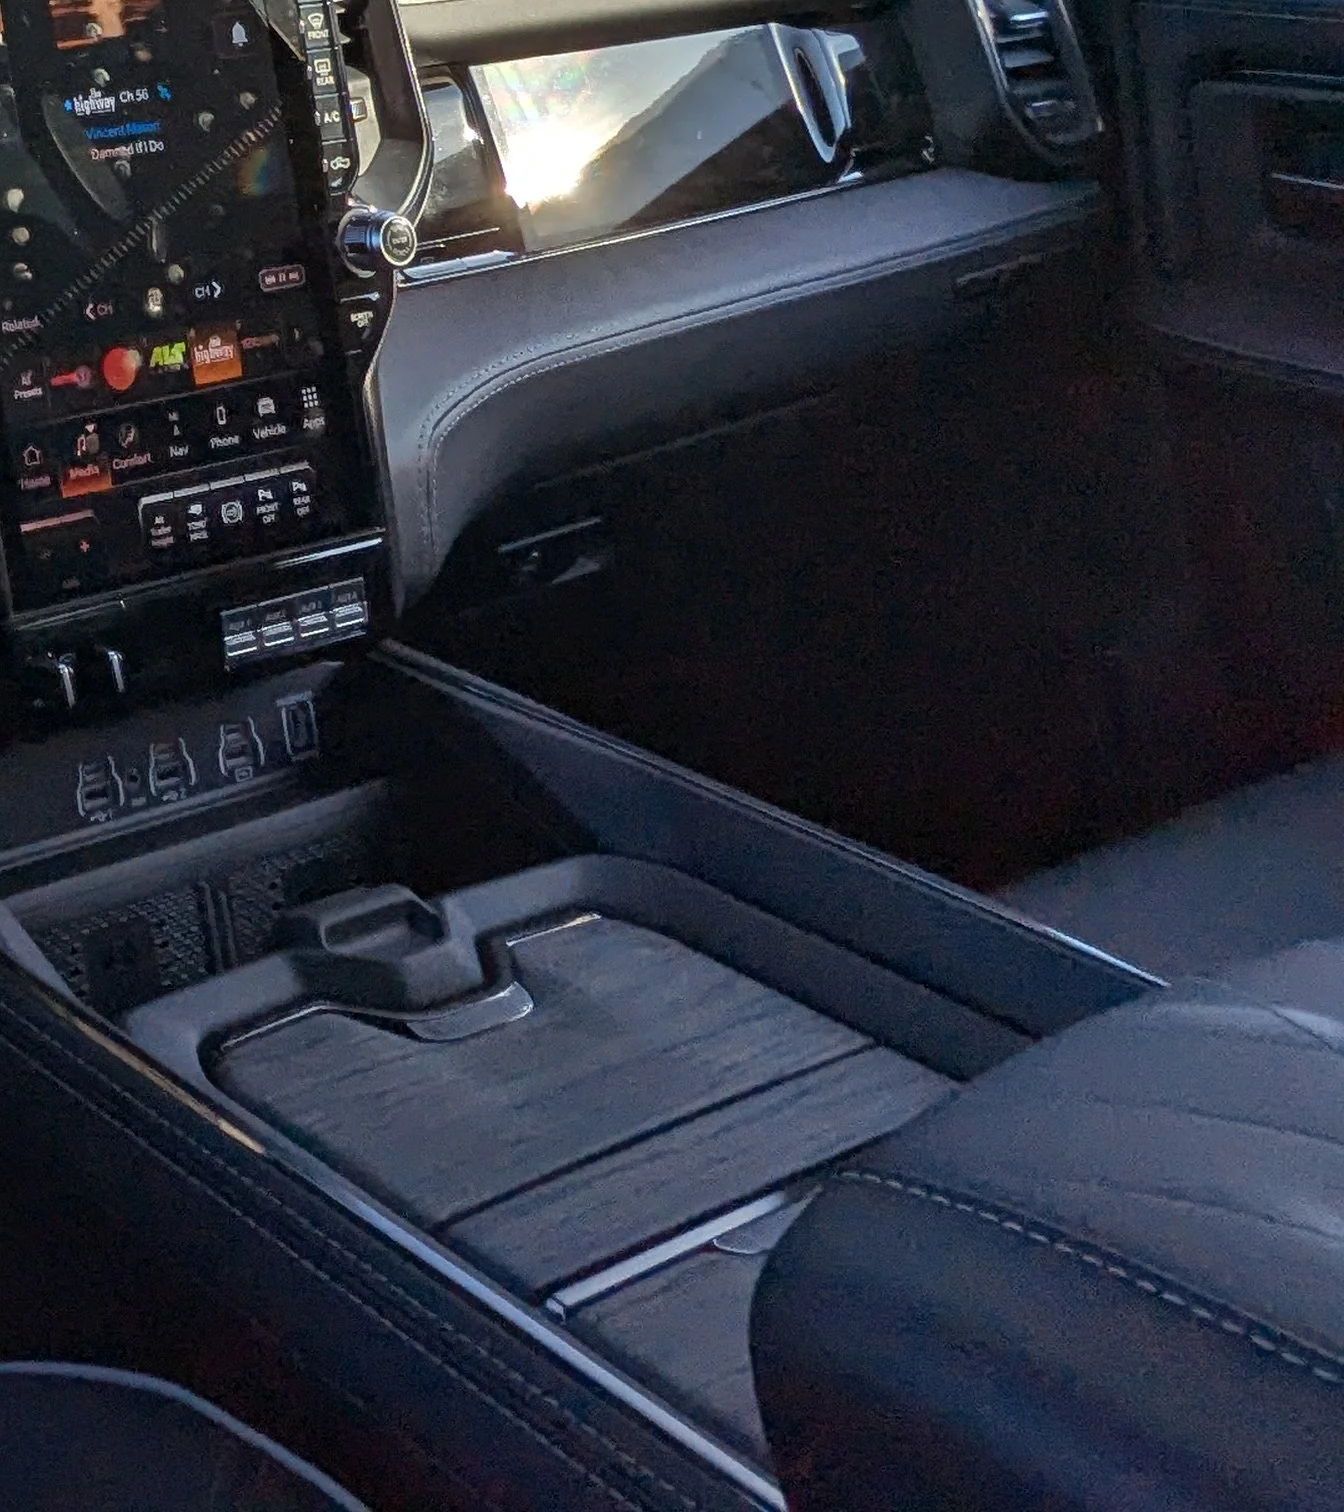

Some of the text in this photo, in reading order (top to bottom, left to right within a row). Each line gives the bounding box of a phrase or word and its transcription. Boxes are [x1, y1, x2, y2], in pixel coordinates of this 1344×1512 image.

[307, 28, 330, 41] FRONT
[74, 94, 117, 117] highway
[323, 109, 341, 125] A/C
[149, 340, 187, 367] ALT
[252, 421, 287, 441] Vehicle
[113, 451, 152, 471] Comfort
[169, 443, 190, 460] Nav
